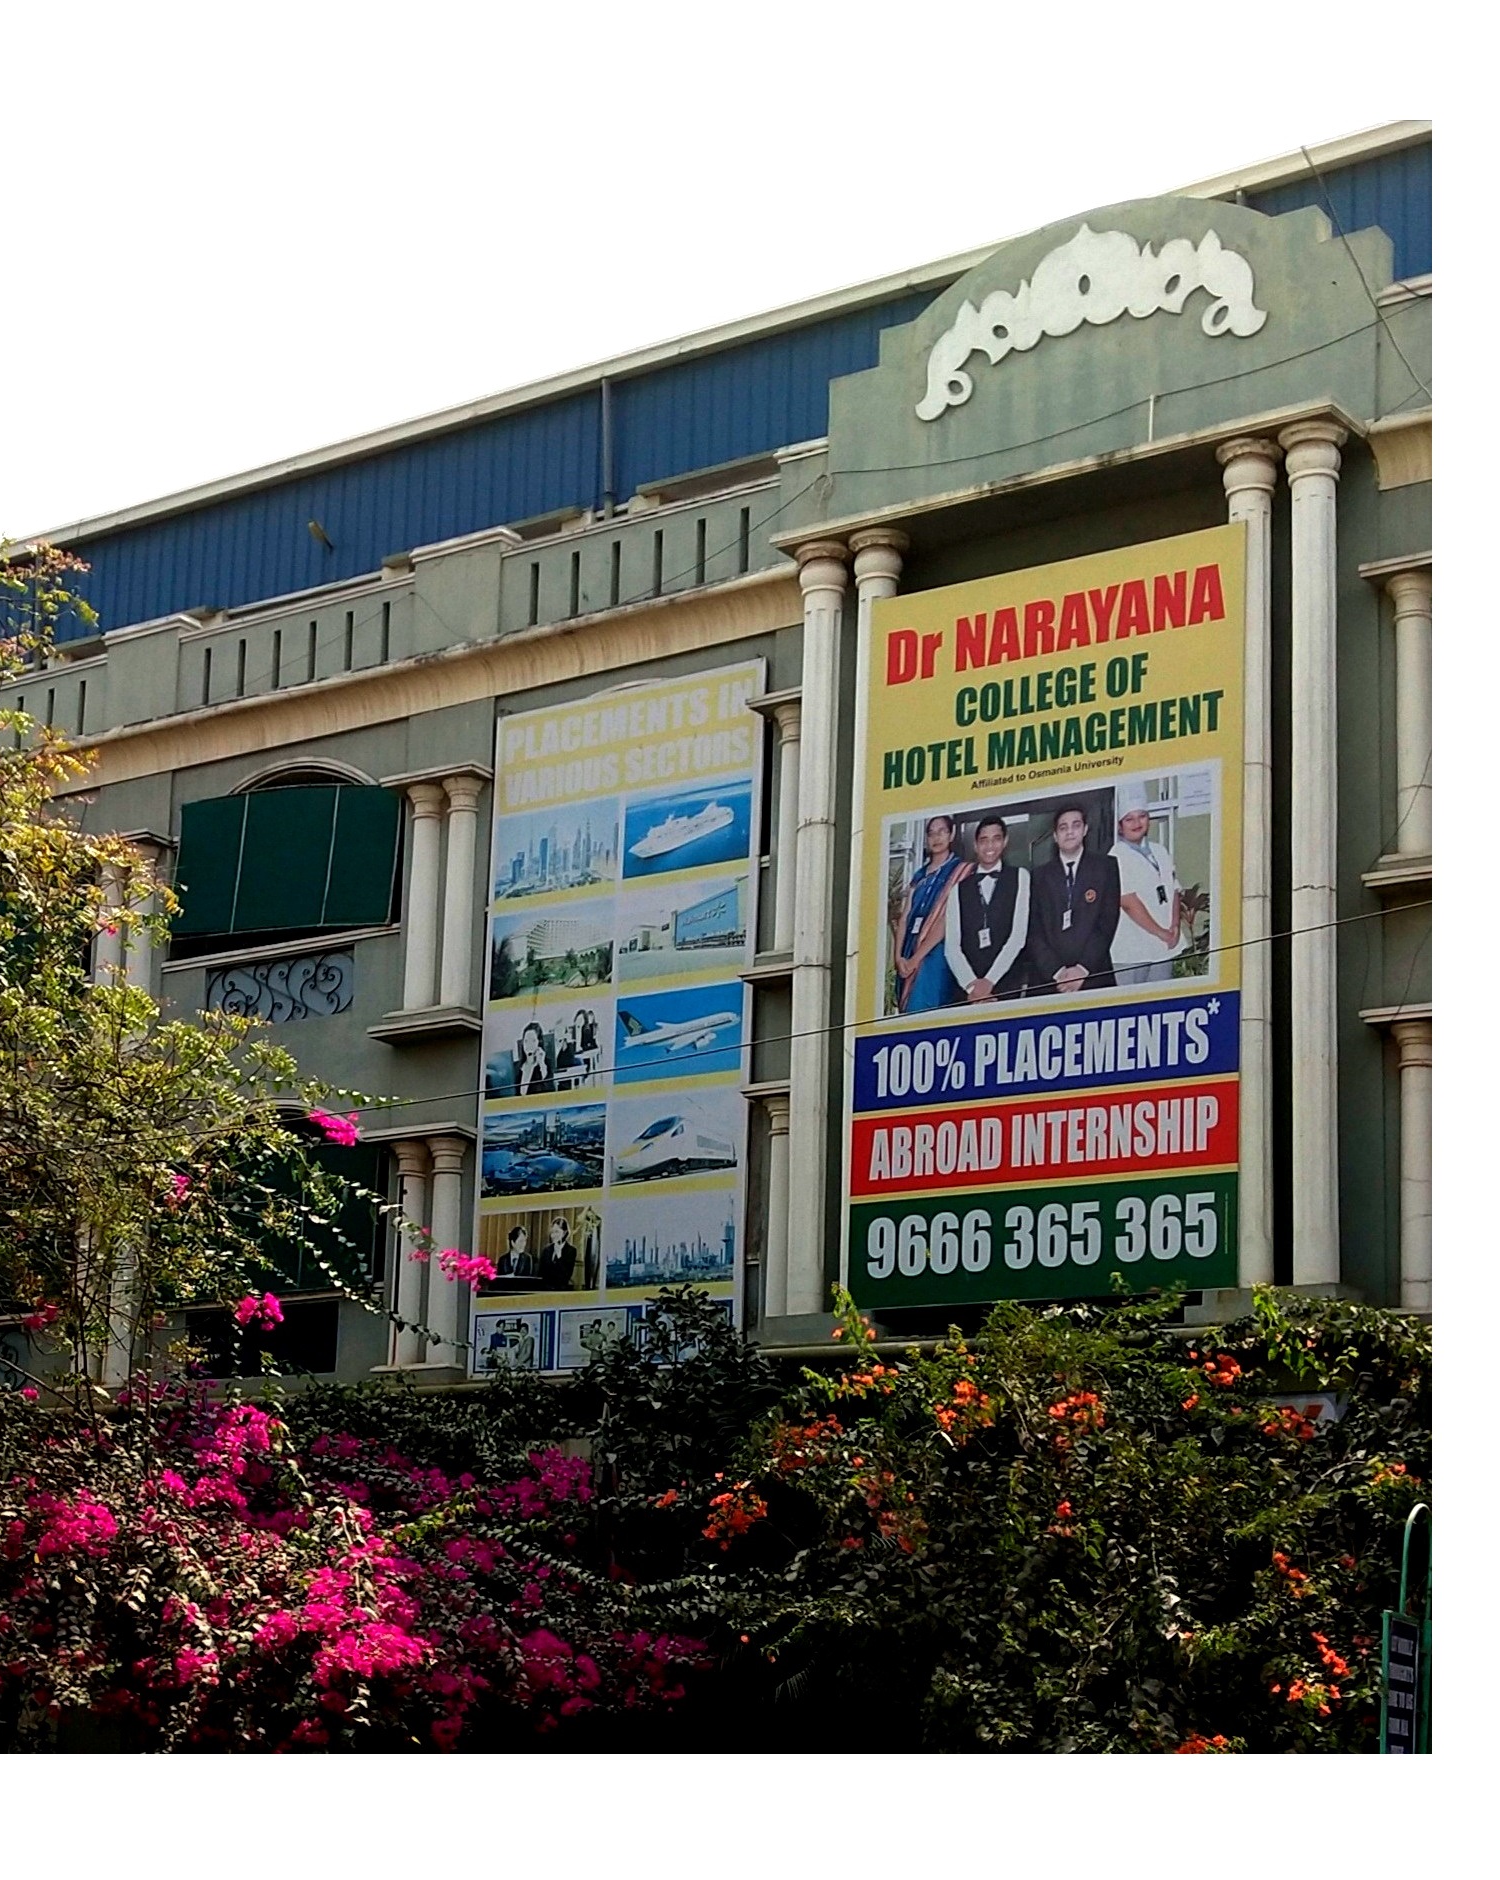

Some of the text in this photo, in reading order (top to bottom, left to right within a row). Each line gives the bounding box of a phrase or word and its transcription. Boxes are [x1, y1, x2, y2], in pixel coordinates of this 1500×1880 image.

[887, 564, 1225, 685] Dr NARAYANA
[506, 679, 752, 764] PLACEMENTS IN
[956, 652, 1148, 727] COLLEGE OF
[507, 726, 749, 805] VARIOUS SECTORS
[884, 690, 1223, 790] HOTEL MANAGEMENT
[971, 755, 1124, 790] Affiliated to Osmania University
[873, 1038, 965, 1097] 100%
[869, 1095, 1219, 1180] ABROAD INTERNSHIP
[867, 1191, 1217, 1279] 9666 365 365
